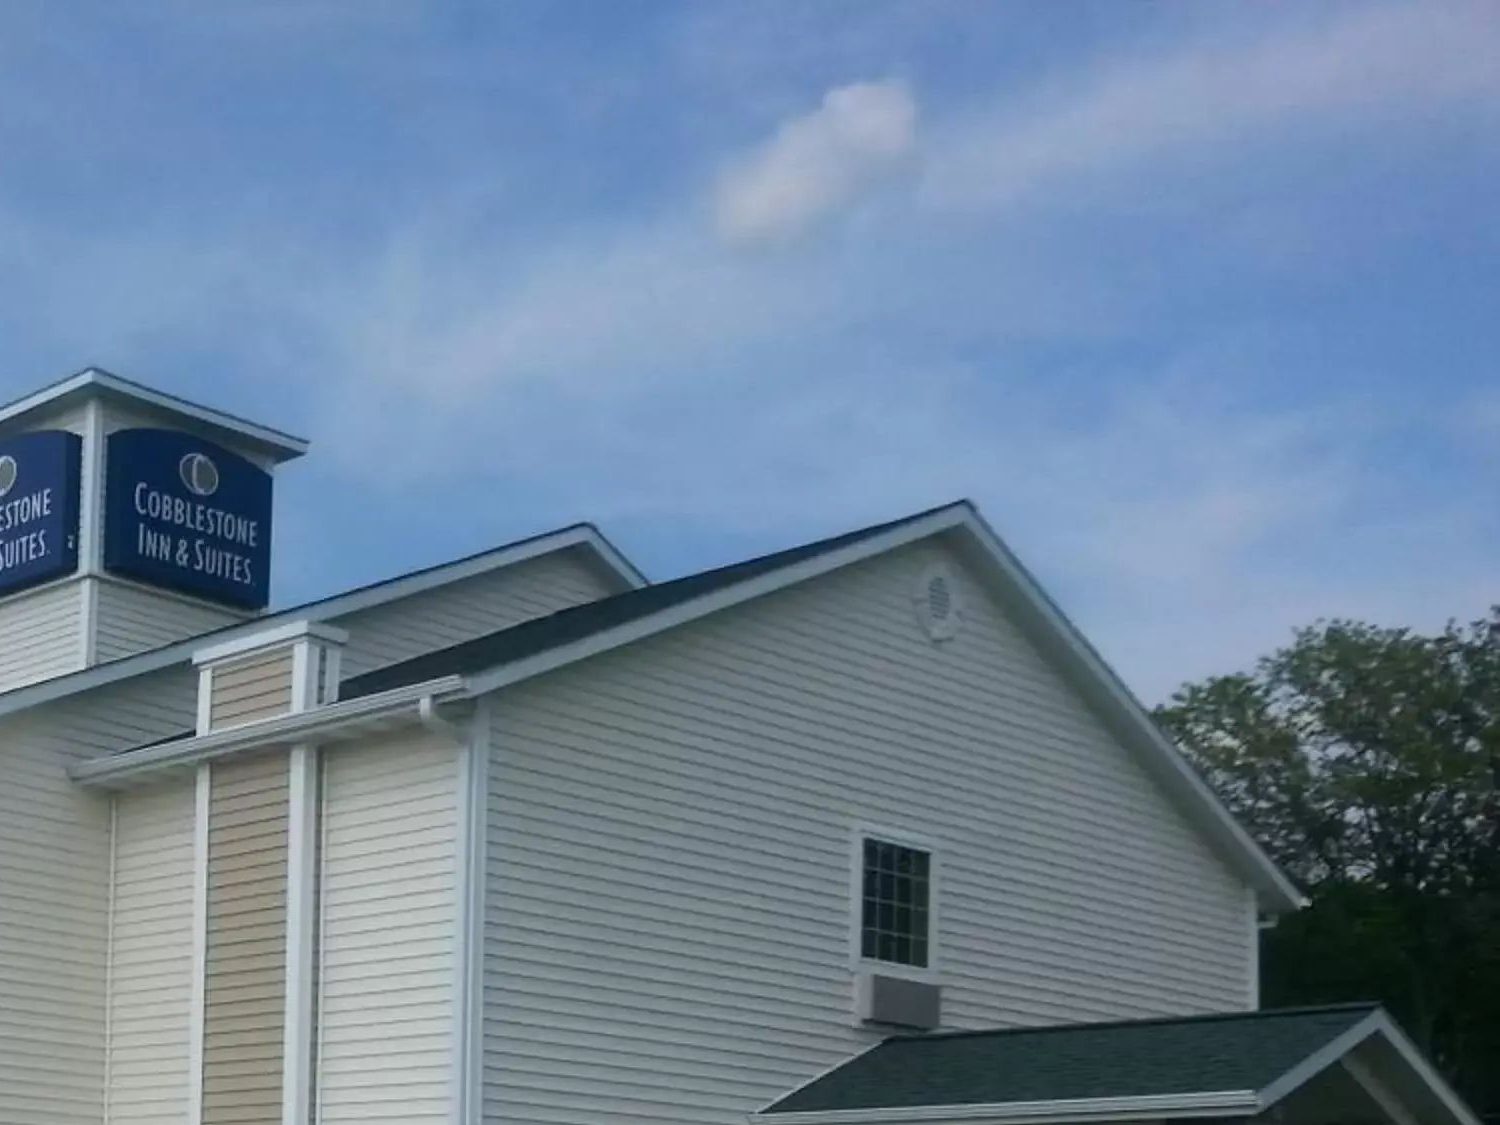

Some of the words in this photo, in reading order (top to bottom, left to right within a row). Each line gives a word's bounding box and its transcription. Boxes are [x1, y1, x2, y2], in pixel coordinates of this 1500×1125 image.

[134, 481, 257, 547] COBBLESTONE
[137, 522, 171, 561] INN
[175, 538, 189, 568] &
[193, 538, 252, 585] SUITES
